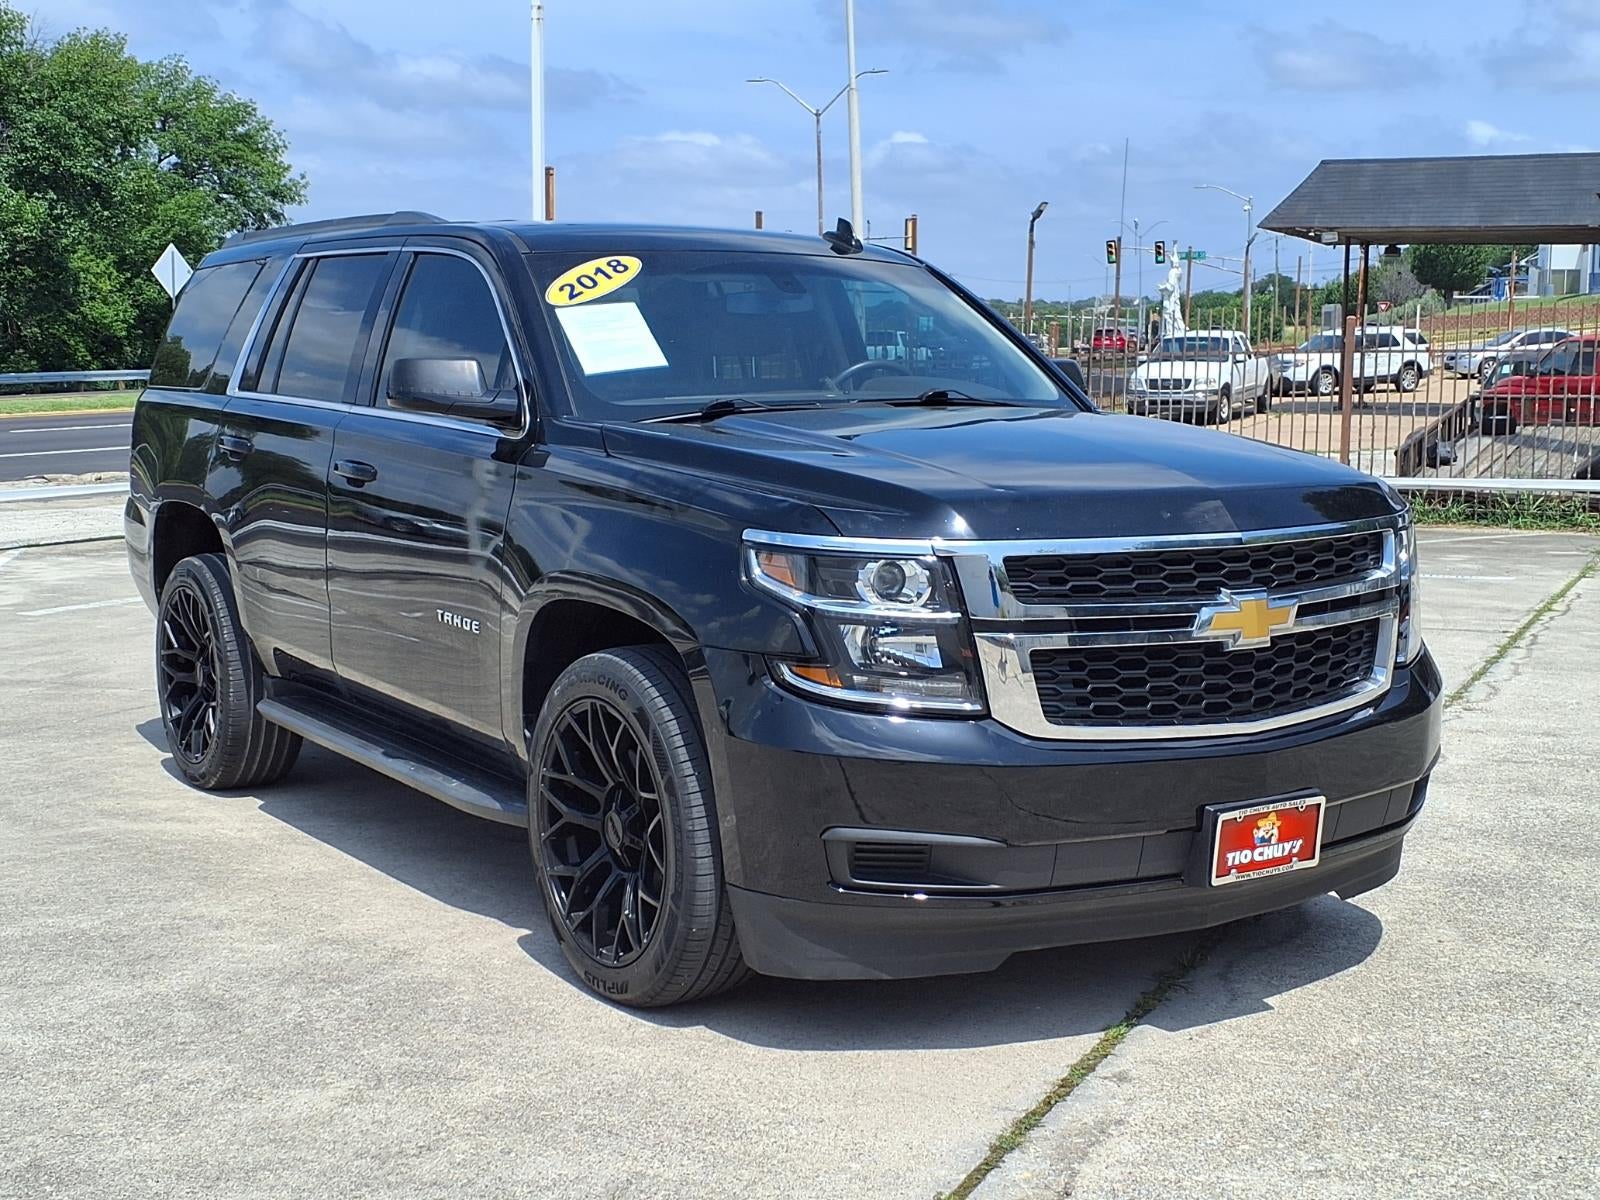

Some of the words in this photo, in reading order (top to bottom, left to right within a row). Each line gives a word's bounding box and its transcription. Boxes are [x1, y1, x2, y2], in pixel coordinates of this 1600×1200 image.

[559, 259, 629, 300] 2018
[436, 609, 480, 634] TAHOE
[1288, 799, 1306, 807] SALES
[1226, 849, 1252, 866] TIO
[1253, 839, 1303, 861] CHUY'S
